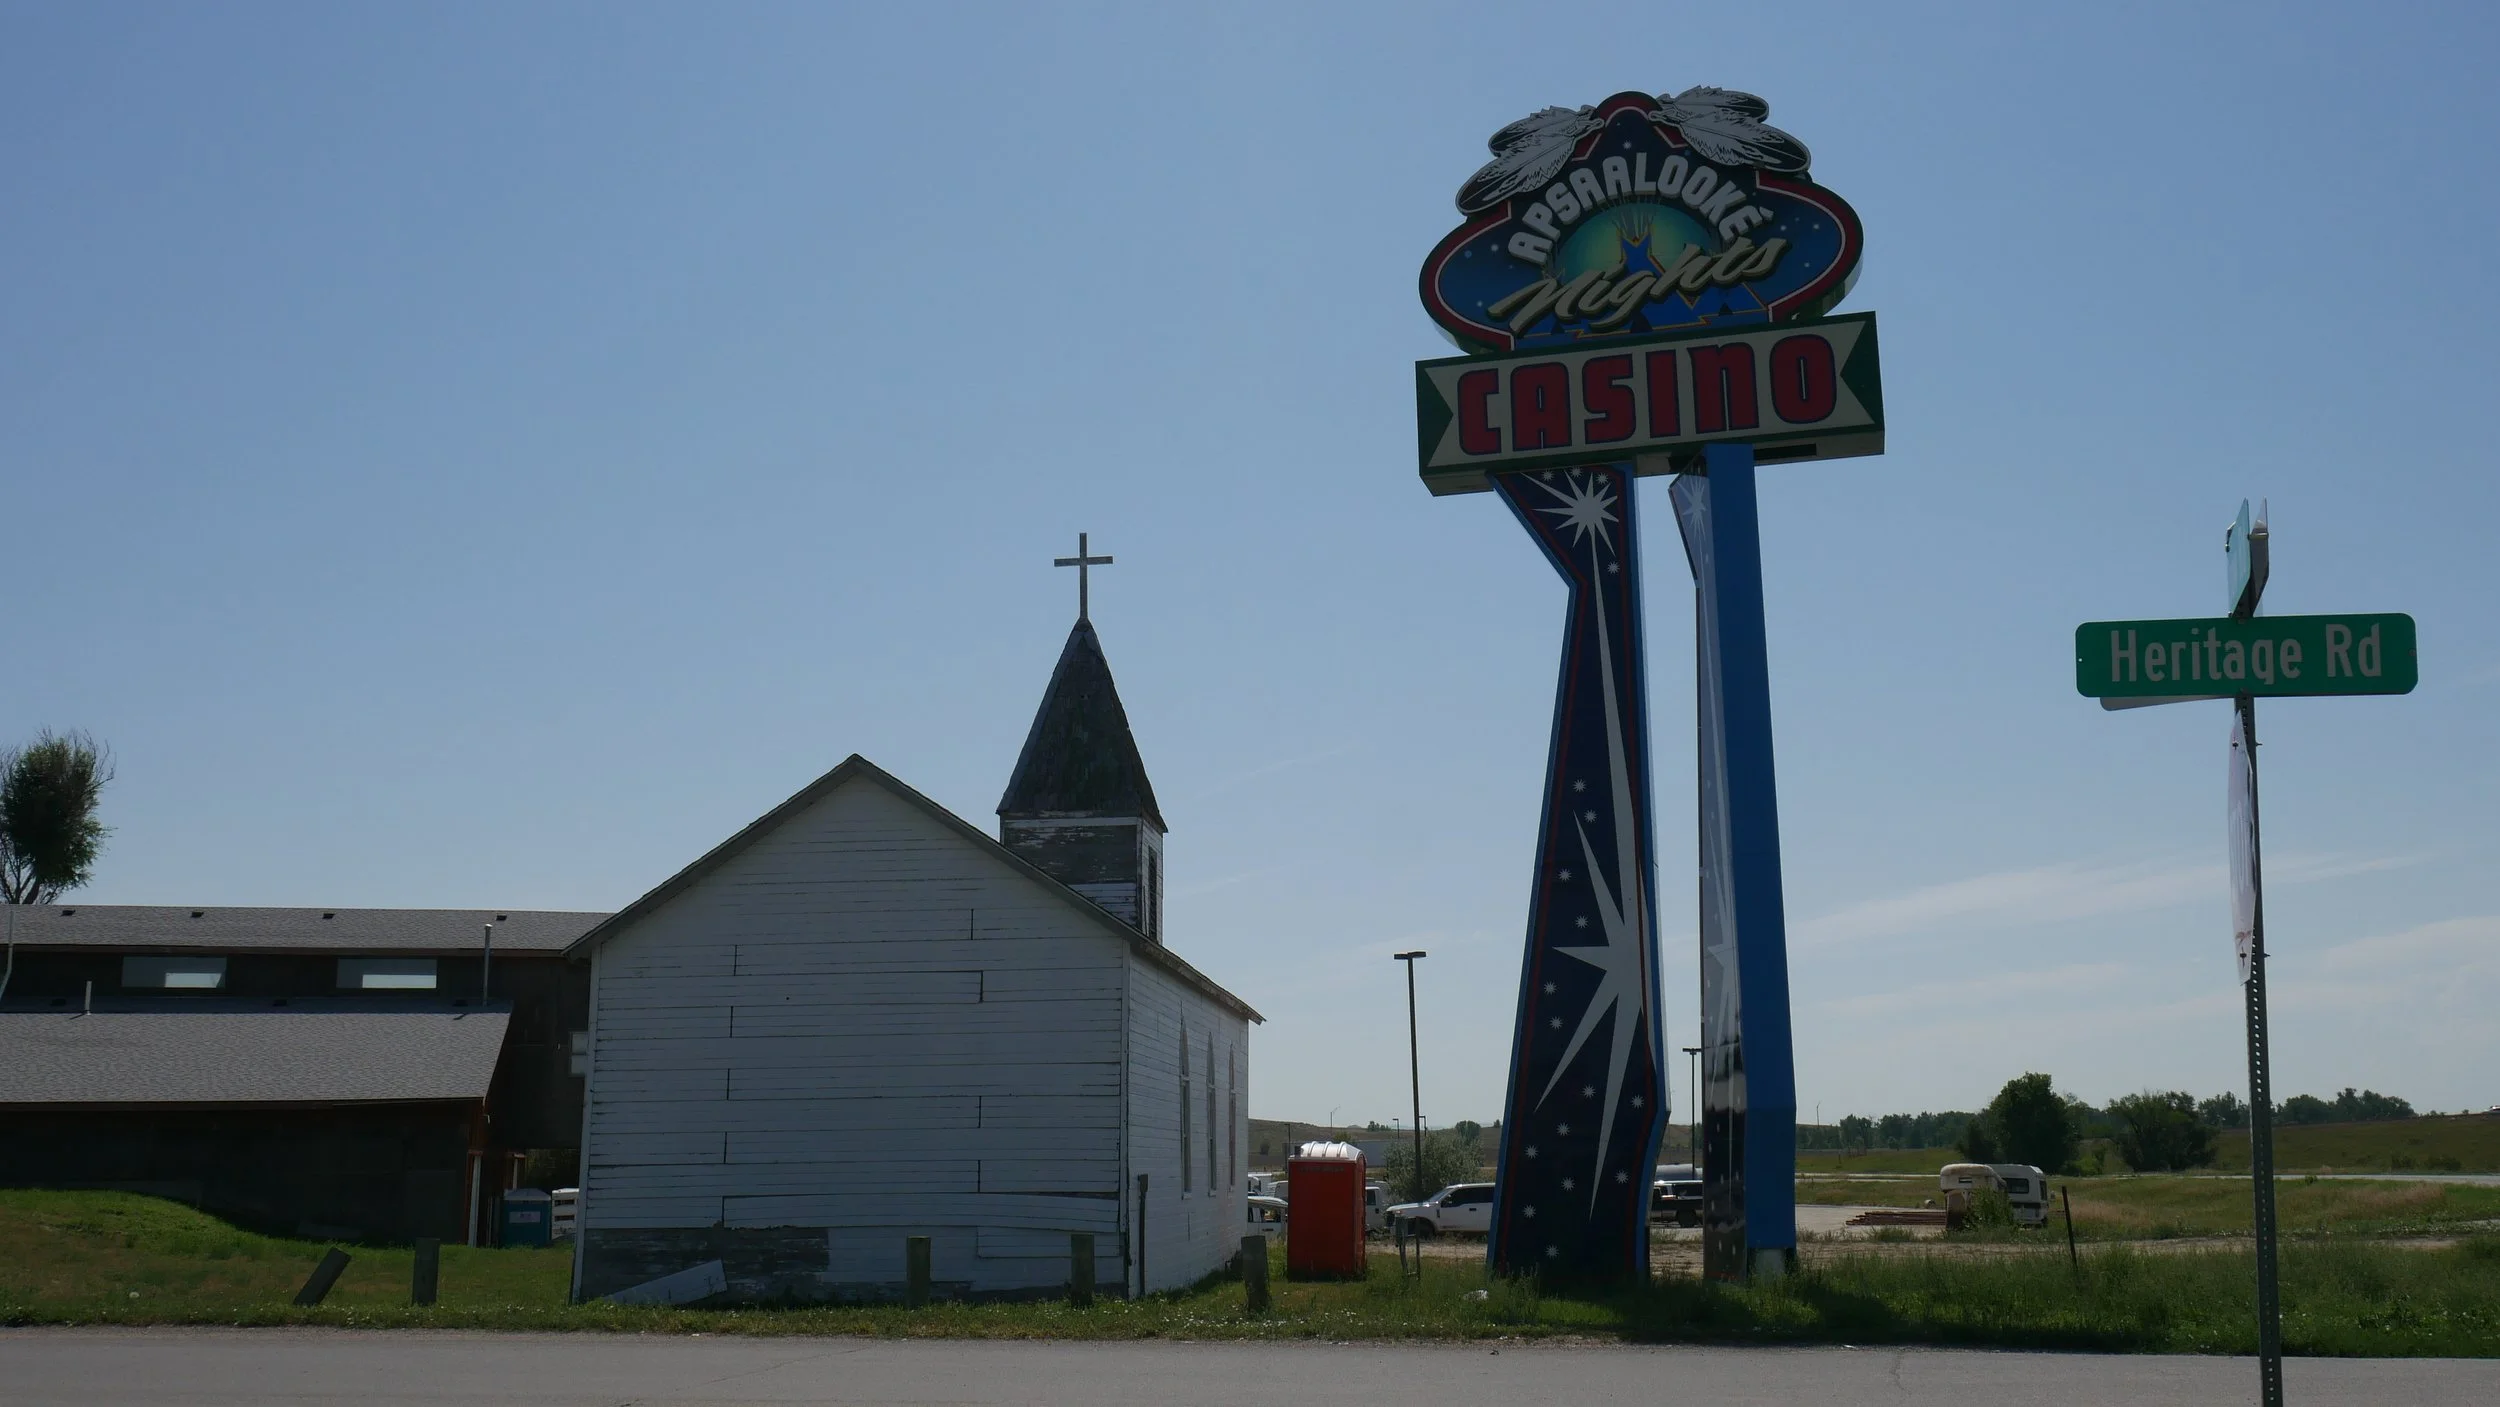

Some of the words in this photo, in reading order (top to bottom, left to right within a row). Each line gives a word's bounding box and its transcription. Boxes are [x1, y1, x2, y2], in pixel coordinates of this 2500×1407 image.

[1486, 236, 1789, 334] Nights
[1456, 333, 1838, 456] CASINO
[2110, 627, 2302, 686] Heritage
[2325, 623, 2383, 679] Rd
